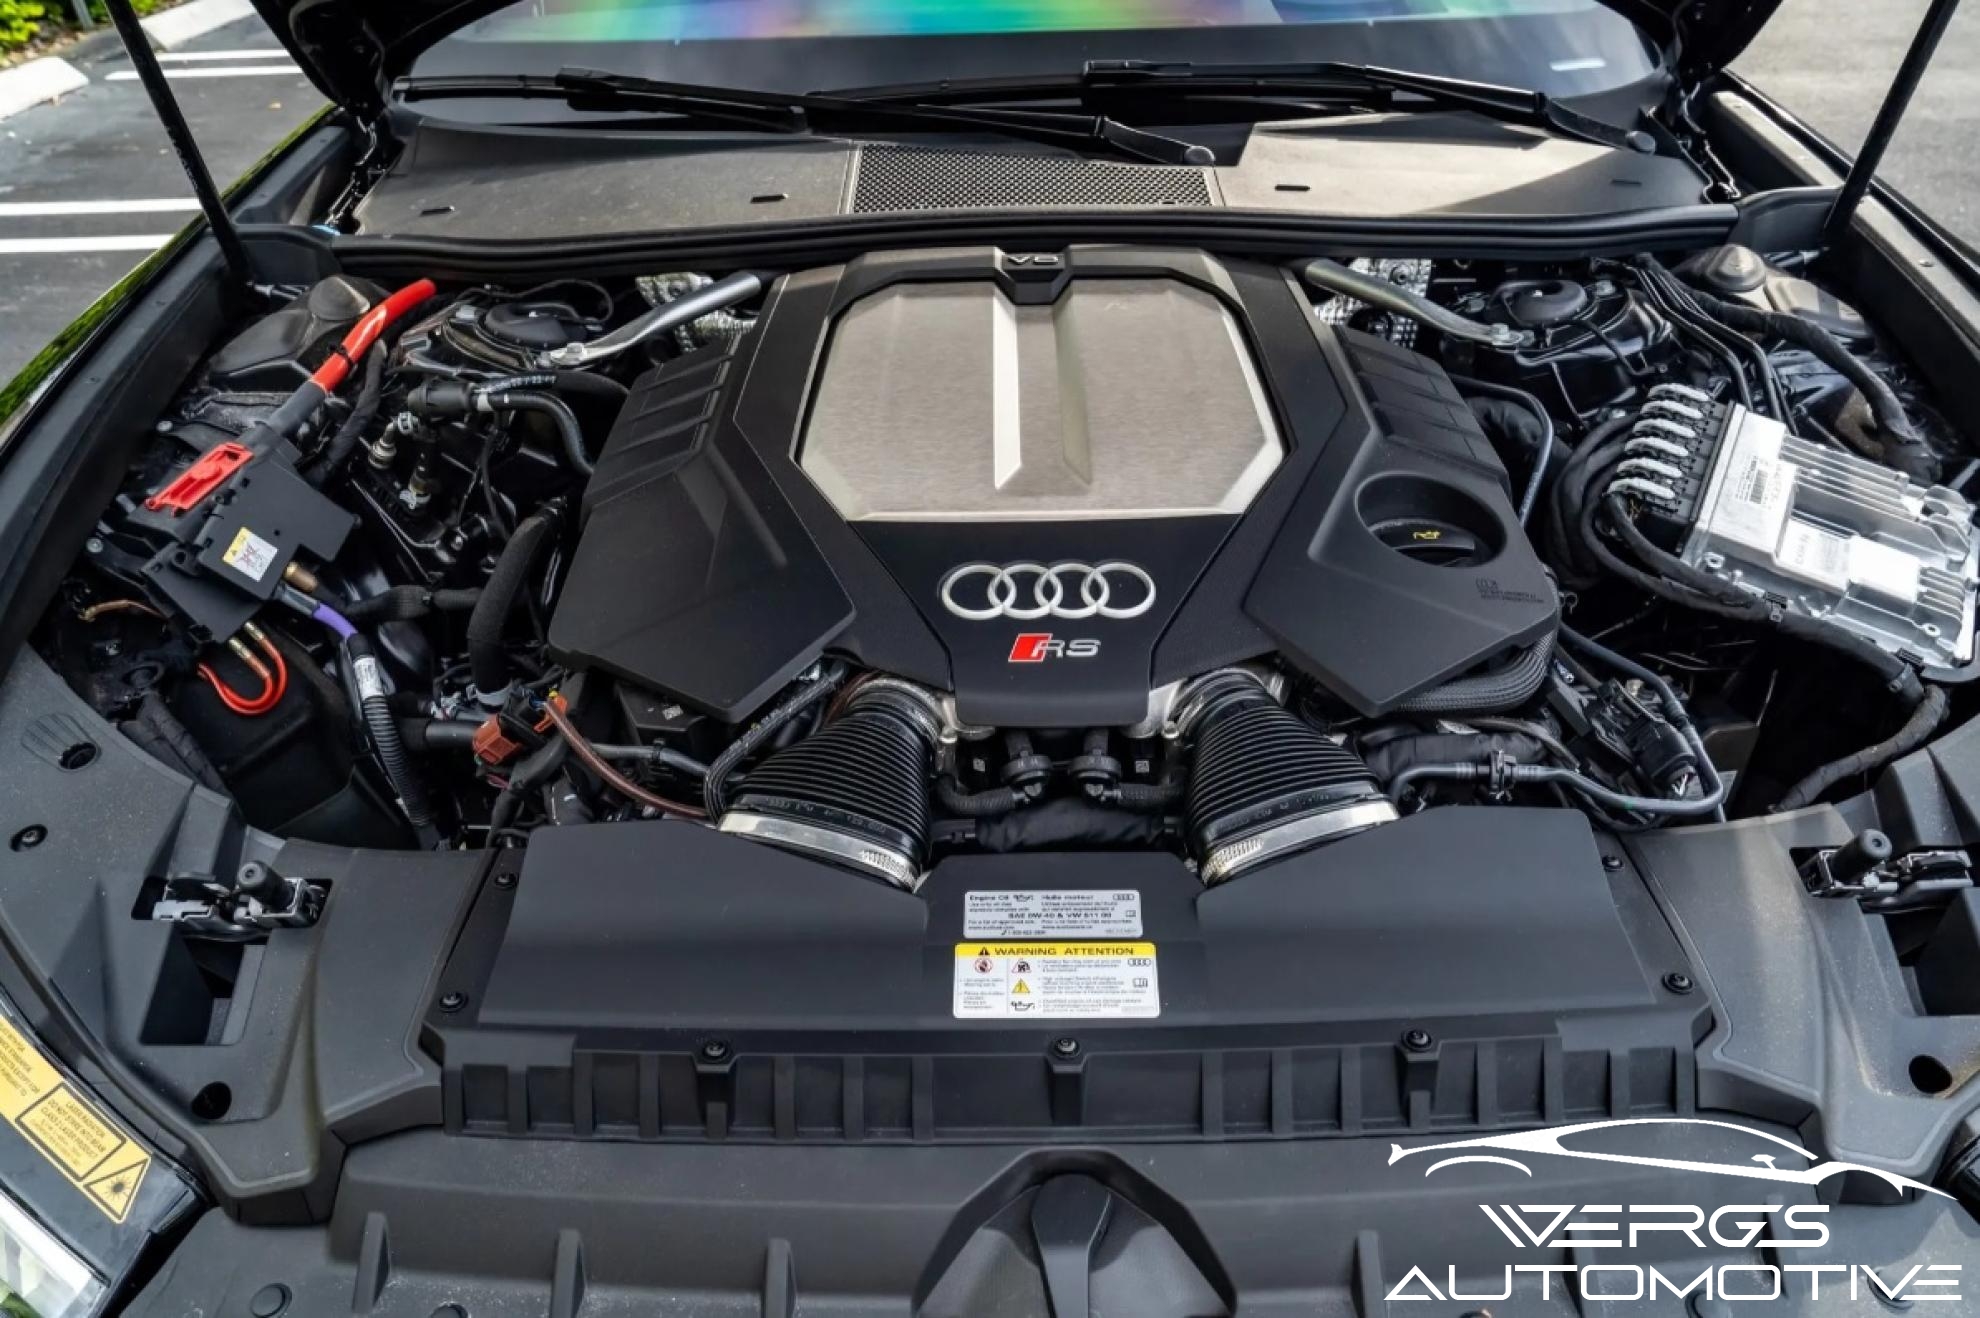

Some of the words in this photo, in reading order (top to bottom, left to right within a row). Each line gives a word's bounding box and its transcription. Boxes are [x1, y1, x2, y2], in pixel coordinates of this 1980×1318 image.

[1028, 637, 1101, 659] RS
[969, 894, 996, 902] Engine
[994, 947, 1056, 956] WARNING
[1064, 947, 1134, 956] ATTENTION
